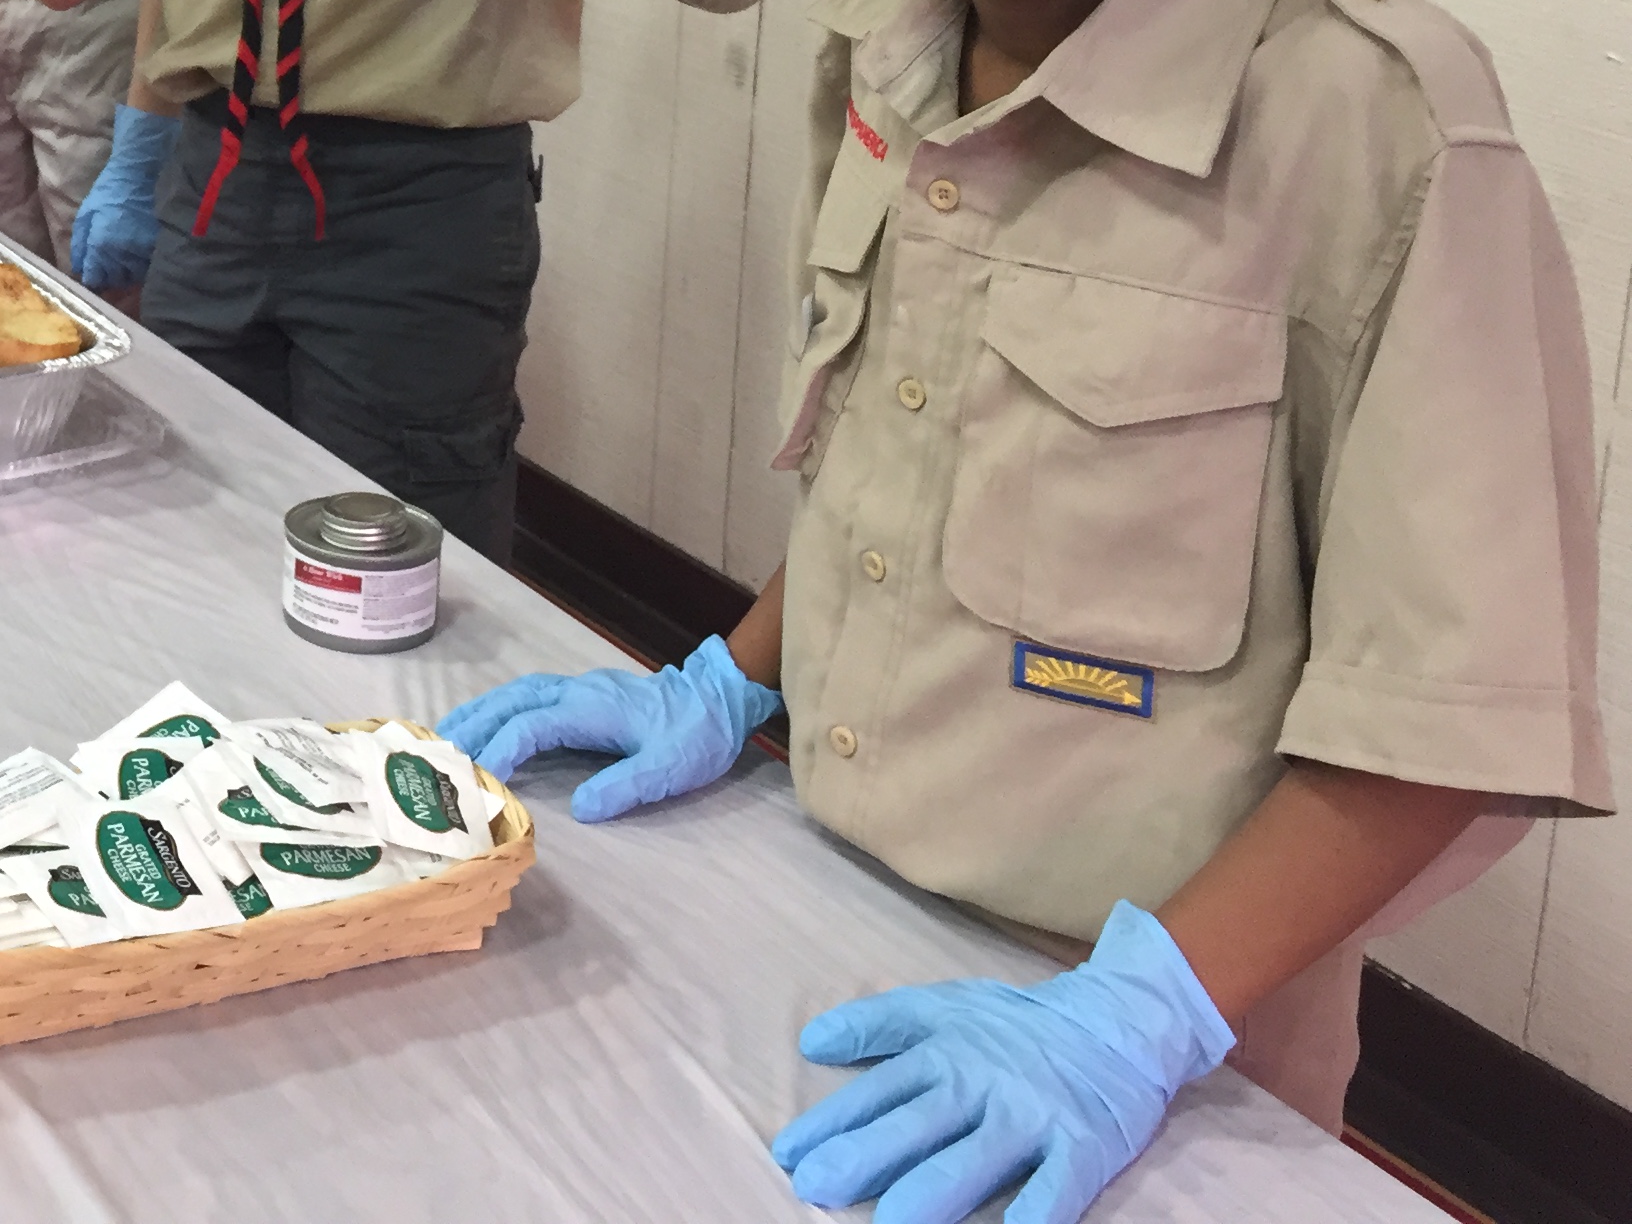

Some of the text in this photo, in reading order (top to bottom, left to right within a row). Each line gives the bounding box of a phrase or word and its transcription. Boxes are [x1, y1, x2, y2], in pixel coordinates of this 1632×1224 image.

[398, 758, 433, 822] PARMESAN
[107, 822, 164, 903] PARMESAN
[107, 848, 133, 883] CHEESE
[135, 843, 162, 880] GRATED
[147, 826, 192, 889] SARGENTO
[280, 846, 372, 866] PARMESAN
[313, 862, 352, 873] CHEESE
